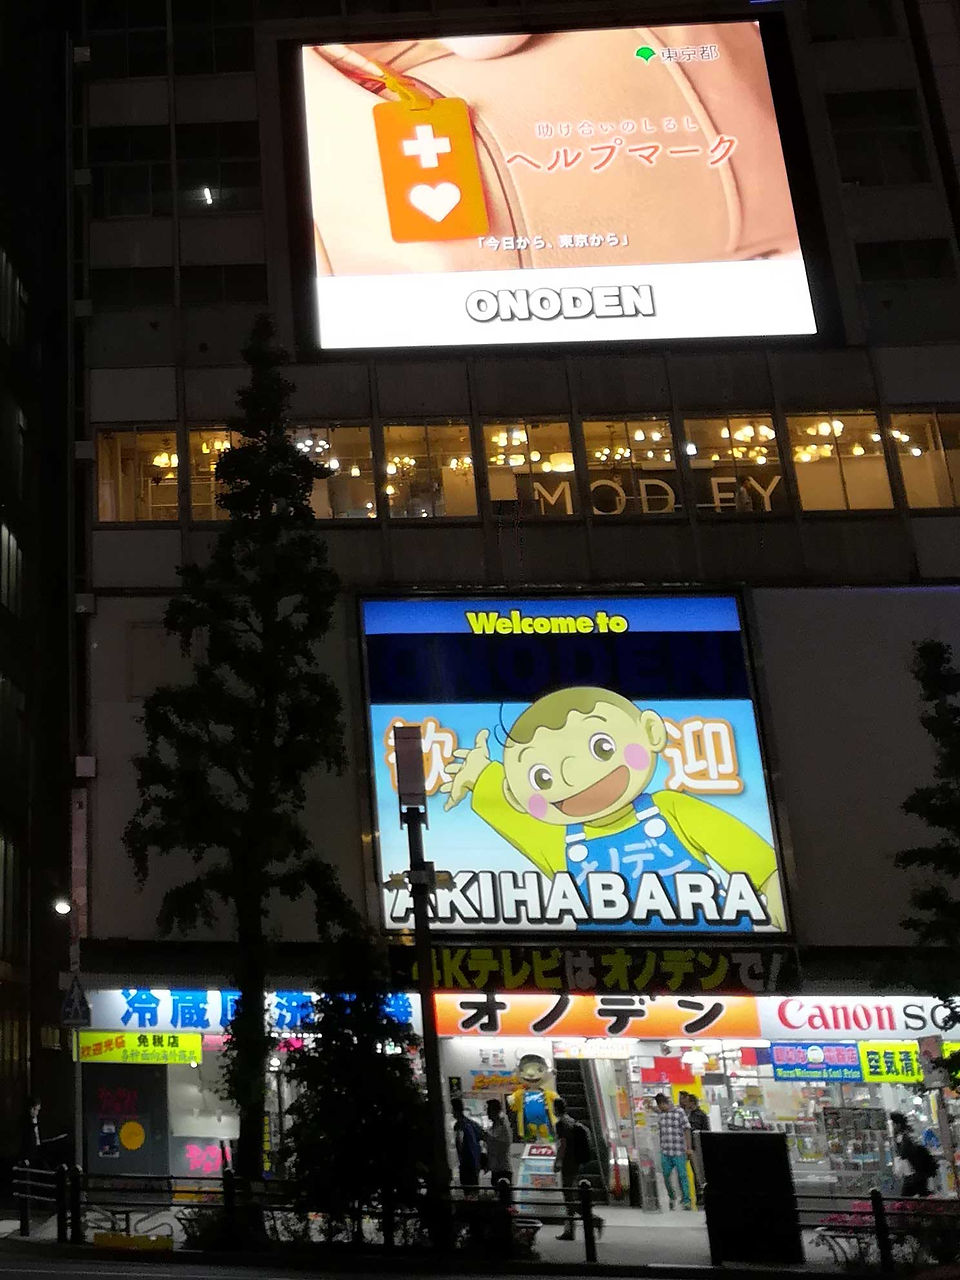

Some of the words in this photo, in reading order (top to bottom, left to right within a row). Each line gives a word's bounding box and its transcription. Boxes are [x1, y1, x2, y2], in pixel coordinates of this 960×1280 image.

[660, 43, 719, 63] 東京都
[535, 116, 698, 138] 助け合いのしるし
[507, 133, 739, 174] ヘルプマーク
[465, 284, 657, 323] ONODEN
[465, 609, 593, 636] Welcome
[597, 610, 629, 635] to
[460, 994, 724, 1035] オノデン
[777, 998, 897, 1031] Canon
[137, 1033, 180, 1048] 免税店
